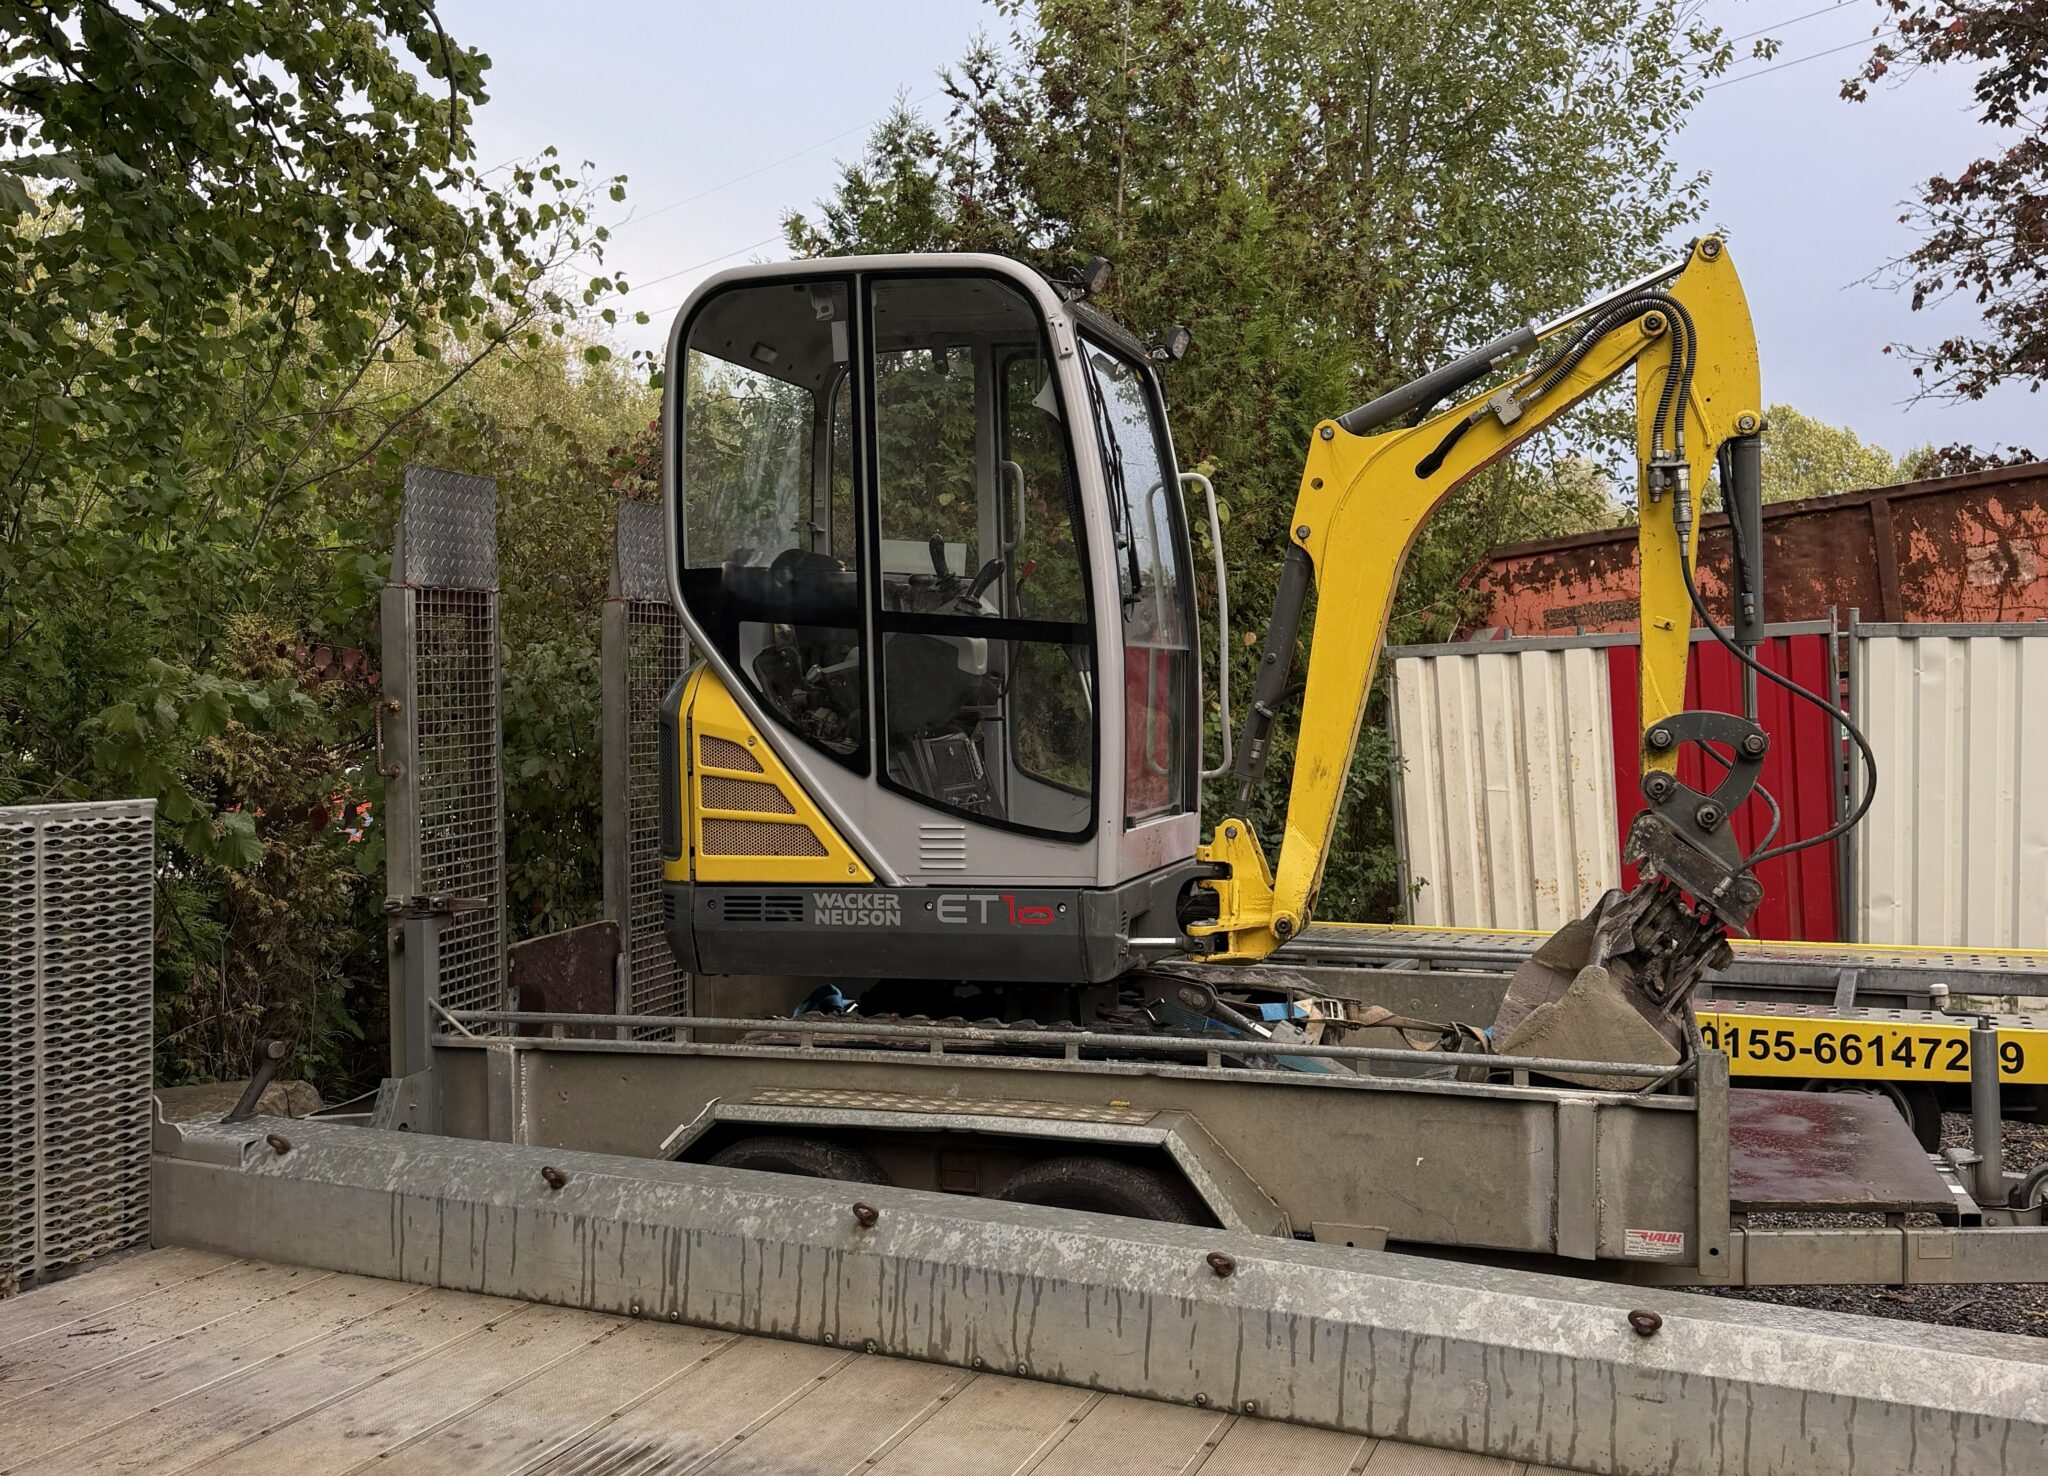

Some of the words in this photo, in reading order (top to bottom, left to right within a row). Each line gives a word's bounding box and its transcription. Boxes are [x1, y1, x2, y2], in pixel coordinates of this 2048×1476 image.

[813, 893, 901, 909] WACKER
[815, 909, 901, 926] NEUSON
[1700, 1026, 2025, 1074] 0155-6614729
